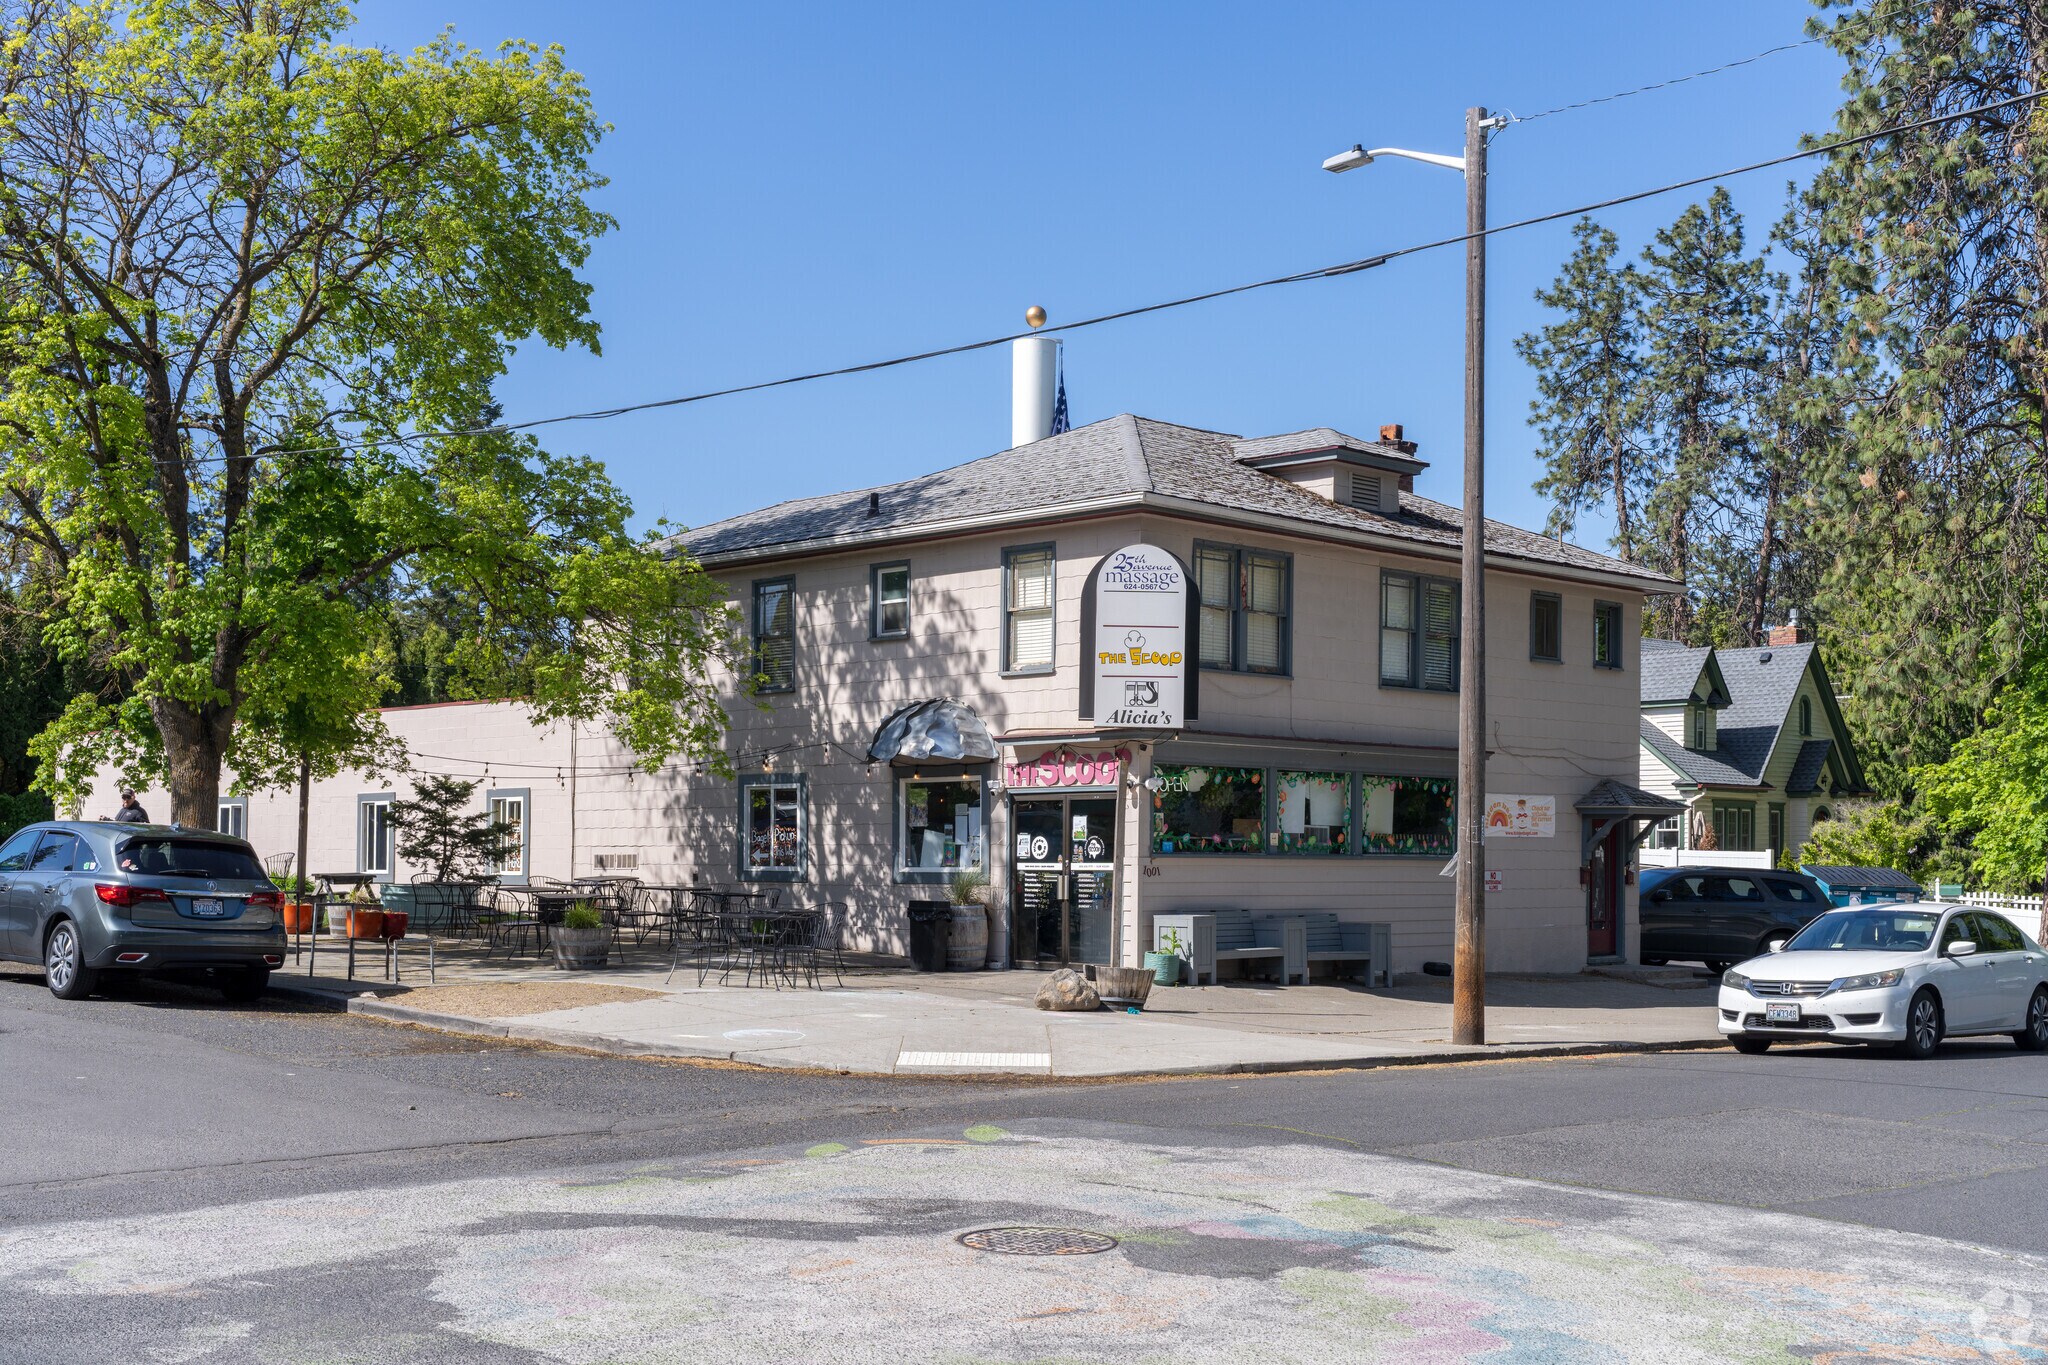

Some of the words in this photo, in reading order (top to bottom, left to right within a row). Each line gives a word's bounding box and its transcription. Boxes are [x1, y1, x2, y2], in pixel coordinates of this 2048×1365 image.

[1113, 553, 1148, 573] 25th
[1133, 564, 1173, 572] avenue
[1104, 572, 1179, 591] massage
[1098, 652, 1127, 665] THE
[1129, 647, 1183, 667] SCOOP
[1105, 709, 1173, 725] Alicia's
[1006, 762, 1040, 787] THE
[1160, 776, 1189, 792] OPEN
[1143, 865, 1160, 877] 1001
[1490, 871, 1497, 880] NO
[1769, 1008, 1797, 1018] CFW3348
